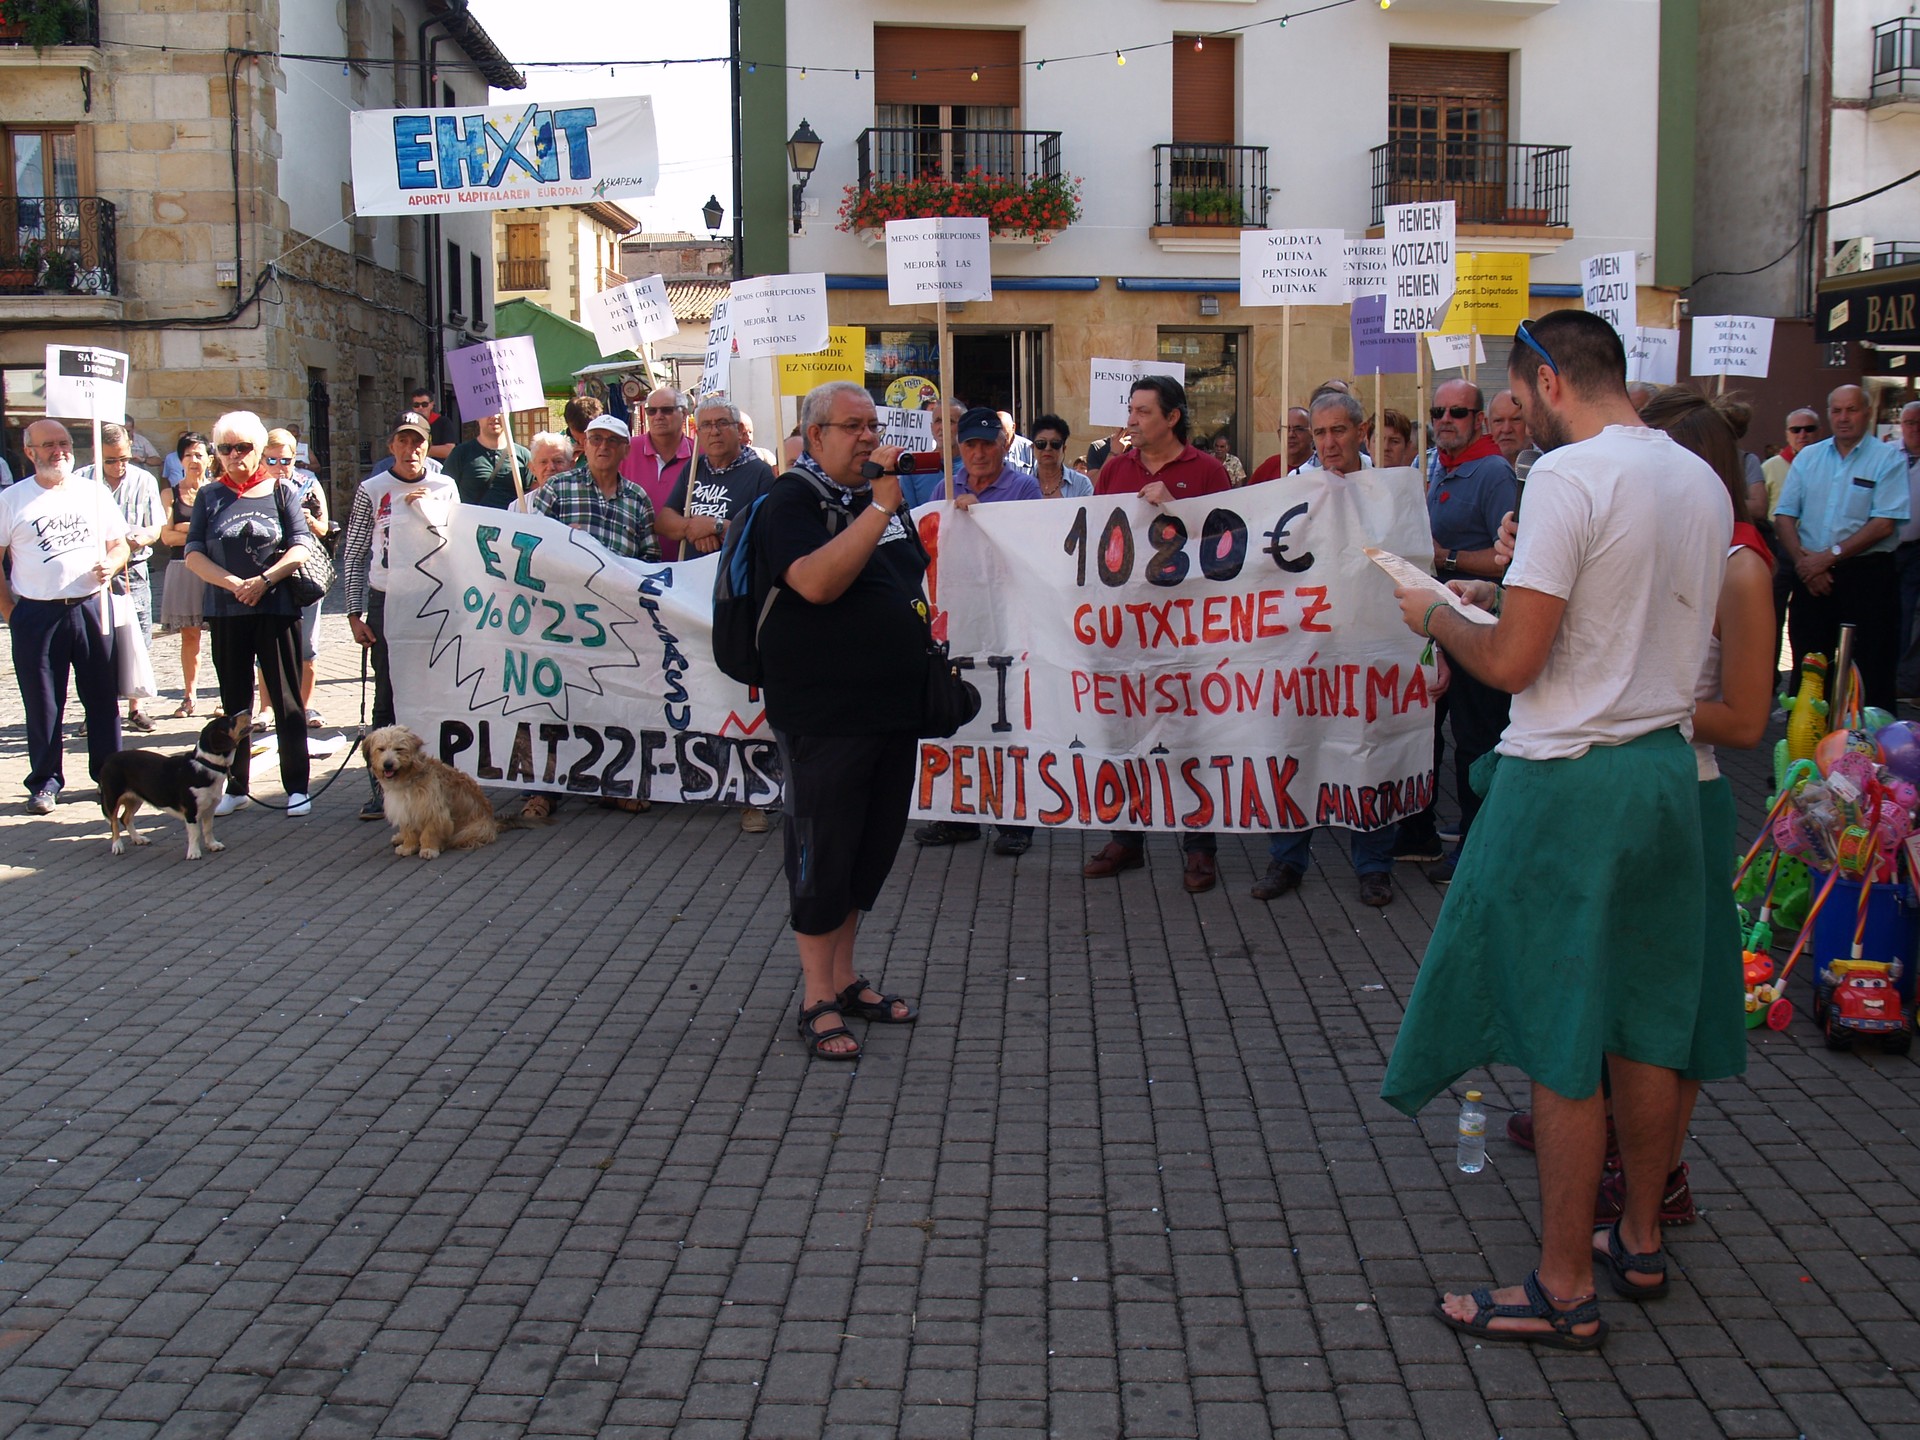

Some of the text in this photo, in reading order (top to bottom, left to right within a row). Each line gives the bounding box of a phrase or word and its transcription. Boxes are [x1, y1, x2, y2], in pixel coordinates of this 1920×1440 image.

[392, 103, 598, 190] EHXIT
[599, 177, 643, 188] ASKAPENA
[408, 186, 583, 206] APURTU KAPITALAREN EUROPA!
[1398, 207, 1441, 232] HEMEN
[891, 232, 981, 243] MENOS CORRUPCIONES
[1268, 235, 1322, 246] SOLDATA
[1276, 252, 1312, 261] DUINA
[1392, 241, 1449, 267] KOTIZATU
[904, 259, 971, 269] MEJORAR LAS
[1589, 256, 1620, 280] HEMEN
[1262, 268, 1328, 278] PENTSIOAK
[916, 281, 963, 290] PENSIONES
[1272, 284, 1317, 293] DUINAK
[1398, 274, 1440, 297] HEMEN
[734, 287, 816, 302] MENOS CORRUPCIONES
[1586, 282, 1629, 307] KOTIZATU
[1463, 301, 1502, 309] Borbones.
[744, 314, 806, 327] MEJORAR LAS
[1393, 307, 1437, 331] ERABA
[1866, 293, 1916, 333] BAR
[1714, 321, 1756, 329] SOLDATA
[708, 324, 730, 346] ZATU
[753, 335, 797, 346] PENSIONES
[1643, 336, 1667, 345] DUINA
[1719, 333, 1747, 341] DUINA
[470, 349, 514, 365] SOLDATA
[1708, 345, 1758, 355] PENTSIOAK
[786, 363, 853, 372] EZ NEGOZIOA
[1713, 358, 1747, 367] DUINAK
[1095, 371, 1139, 382] PENSION
[887, 411, 923, 429] HEMEN
[1064, 502, 1315, 587] 1080 €
[477, 525, 546, 593] EZ
[1073, 585, 1332, 649] GUTXIENEZ
[503, 648, 562, 698] NO
[1071, 657, 1264, 717] PENSIÓN
[1273, 651, 1429, 723] MÍNIMA
[440, 720, 786, 808] PLAT.22F-SAS
